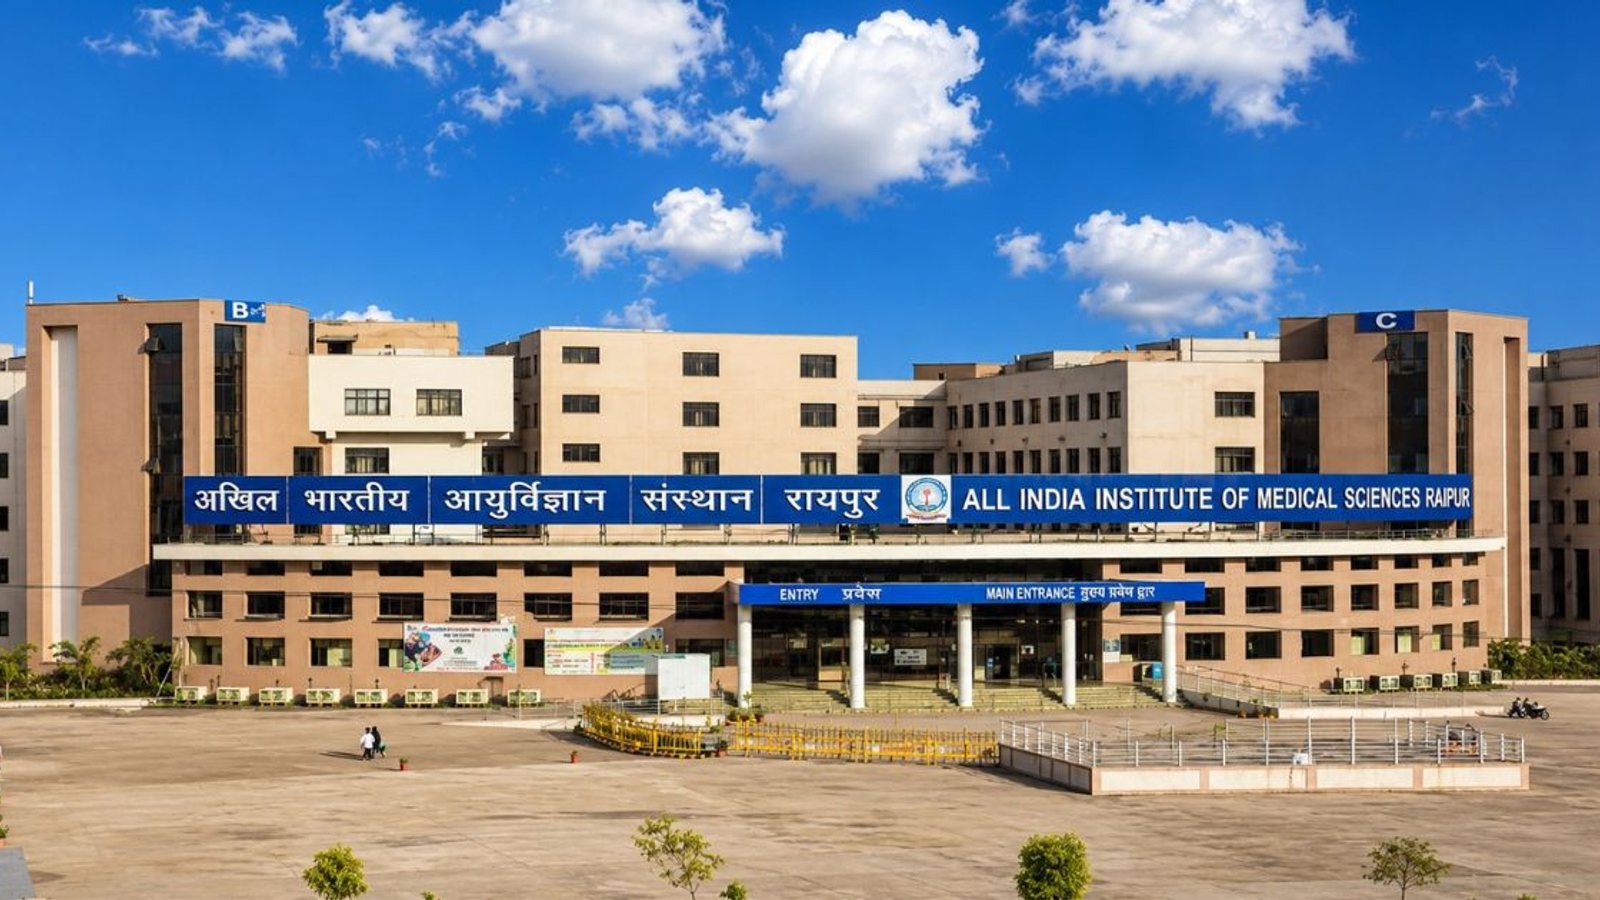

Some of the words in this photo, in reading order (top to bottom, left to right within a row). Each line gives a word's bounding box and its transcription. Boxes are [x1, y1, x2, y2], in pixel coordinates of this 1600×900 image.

[232, 301, 249, 319] B
[1376, 312, 1397, 329] C
[194, 481, 279, 511] अखिल
[304, 481, 410, 511] भारतीय
[444, 481, 607, 519] आयुर्विज्ञान
[640, 482, 754, 511] संस्थान
[784, 489, 881, 519] रायपुर
[962, 488, 1011, 511] ALL
[1020, 488, 1086, 510] INDIA
[1095, 487, 1213, 510] INSTITUTE
[1222, 487, 1249, 510] OF
[1257, 487, 1338, 509] MEDICAL
[1344, 487, 1421, 509] SCIENCES
[1425, 487, 1470, 508] RAIPUR
[780, 588, 819, 601] ENTRY
[986, 587, 1014, 600] MAIN
[1016, 586, 1075, 600] ENTRANCE
